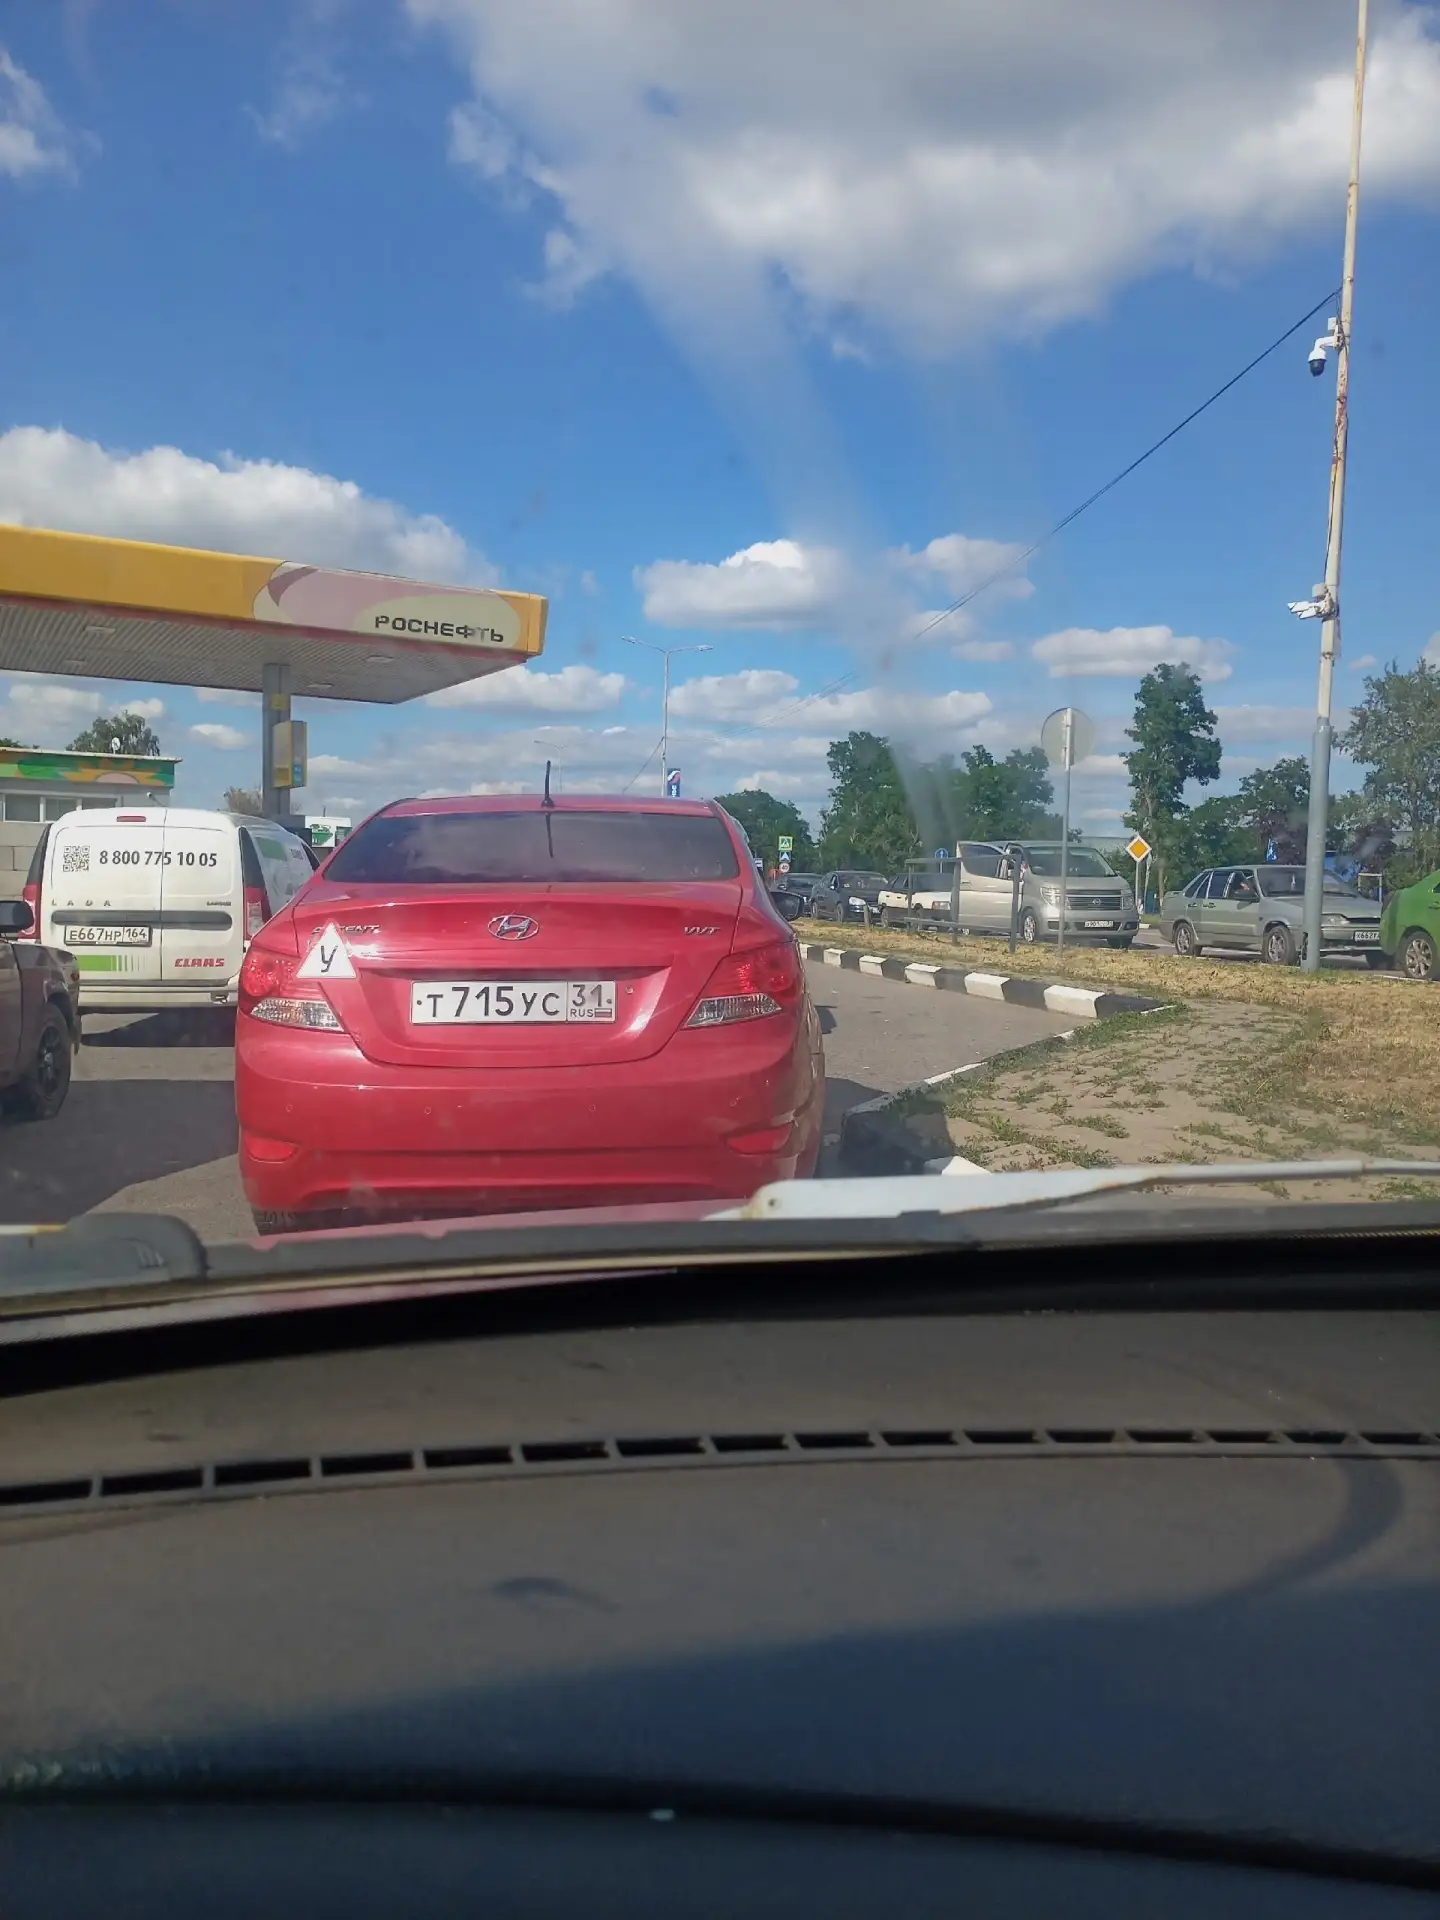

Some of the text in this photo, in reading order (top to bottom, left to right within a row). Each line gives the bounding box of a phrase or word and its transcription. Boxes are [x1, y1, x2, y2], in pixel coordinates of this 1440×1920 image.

[375, 615, 504, 643] РОСНЕФТЬ
[100, 850, 217, 867] 8 800 775 10 05
[125, 928, 147, 939] 164
[174, 957, 225, 968] CLAAS
[571, 984, 603, 1008] 31
[570, 1008, 594, 1018] RUS
